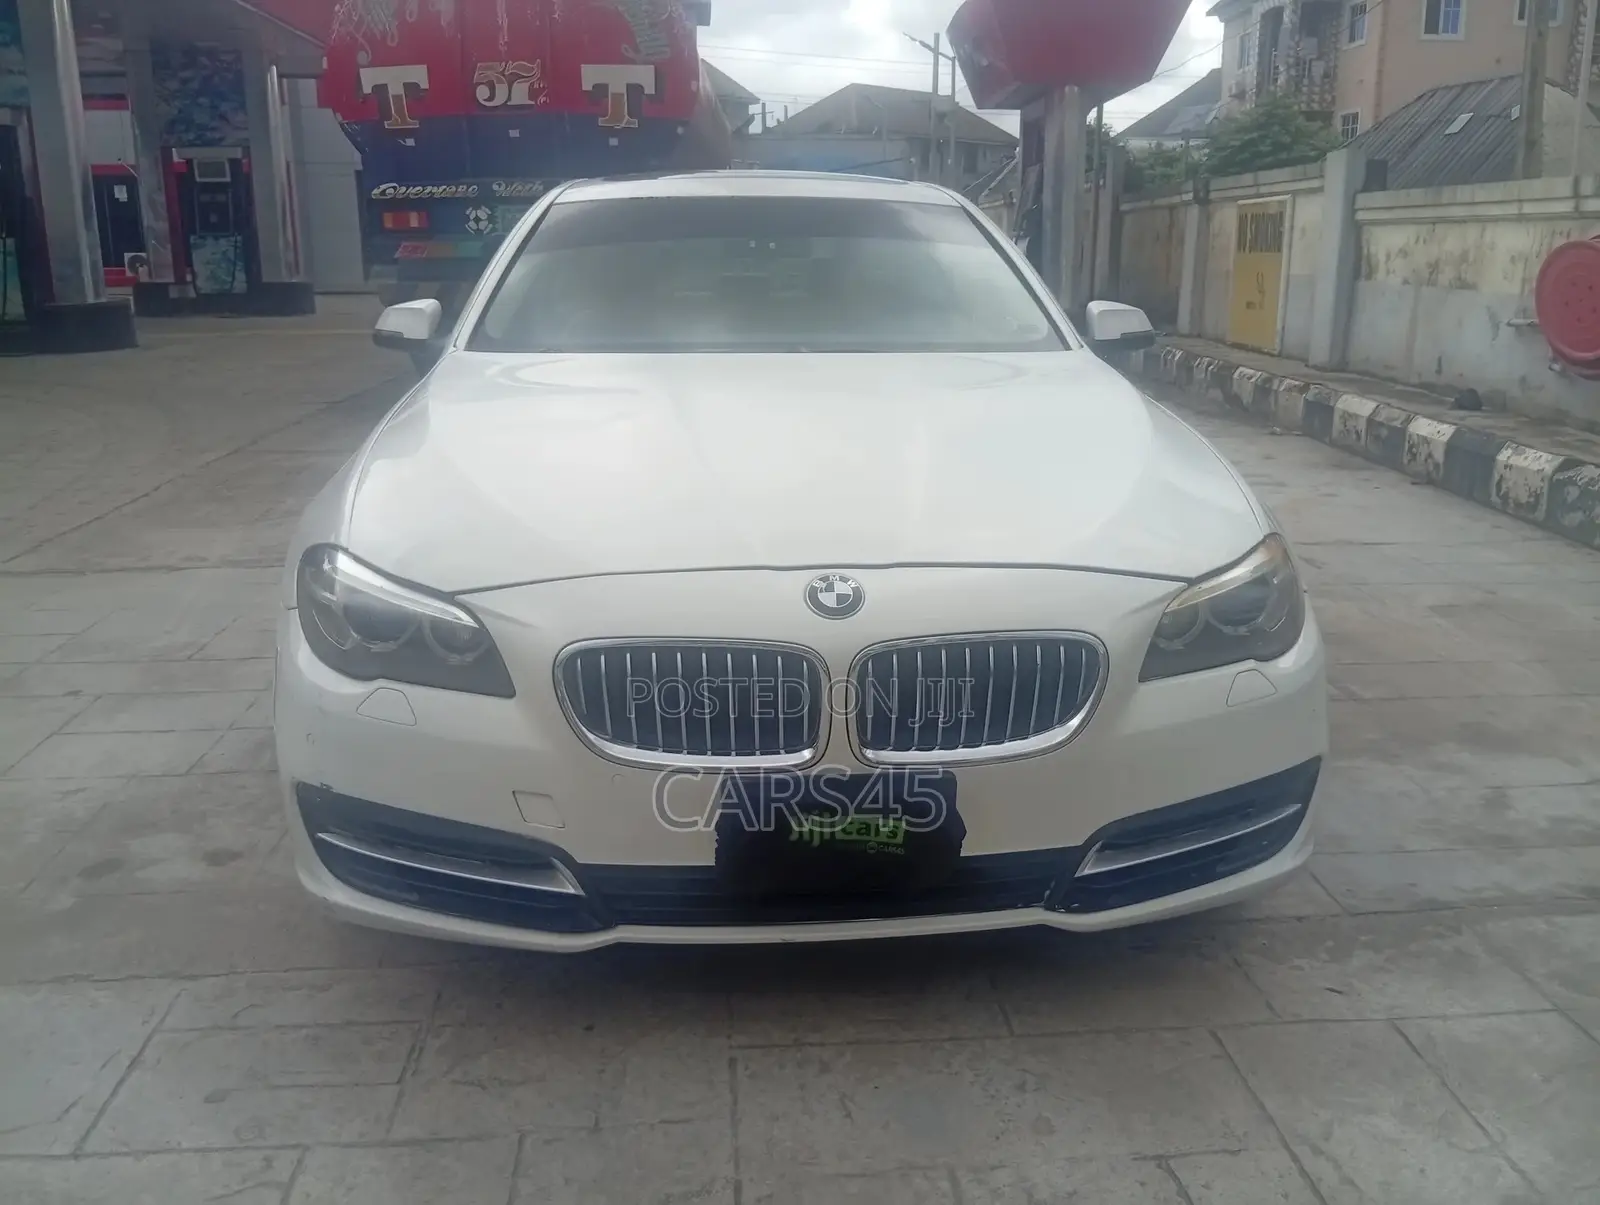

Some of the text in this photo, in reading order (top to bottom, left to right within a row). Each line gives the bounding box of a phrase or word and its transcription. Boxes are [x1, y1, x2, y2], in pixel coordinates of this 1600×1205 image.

[360, 65, 429, 128] T
[474, 60, 541, 106] 57
[581, 64, 655, 128] T
[813, 575, 859, 588] BMW
